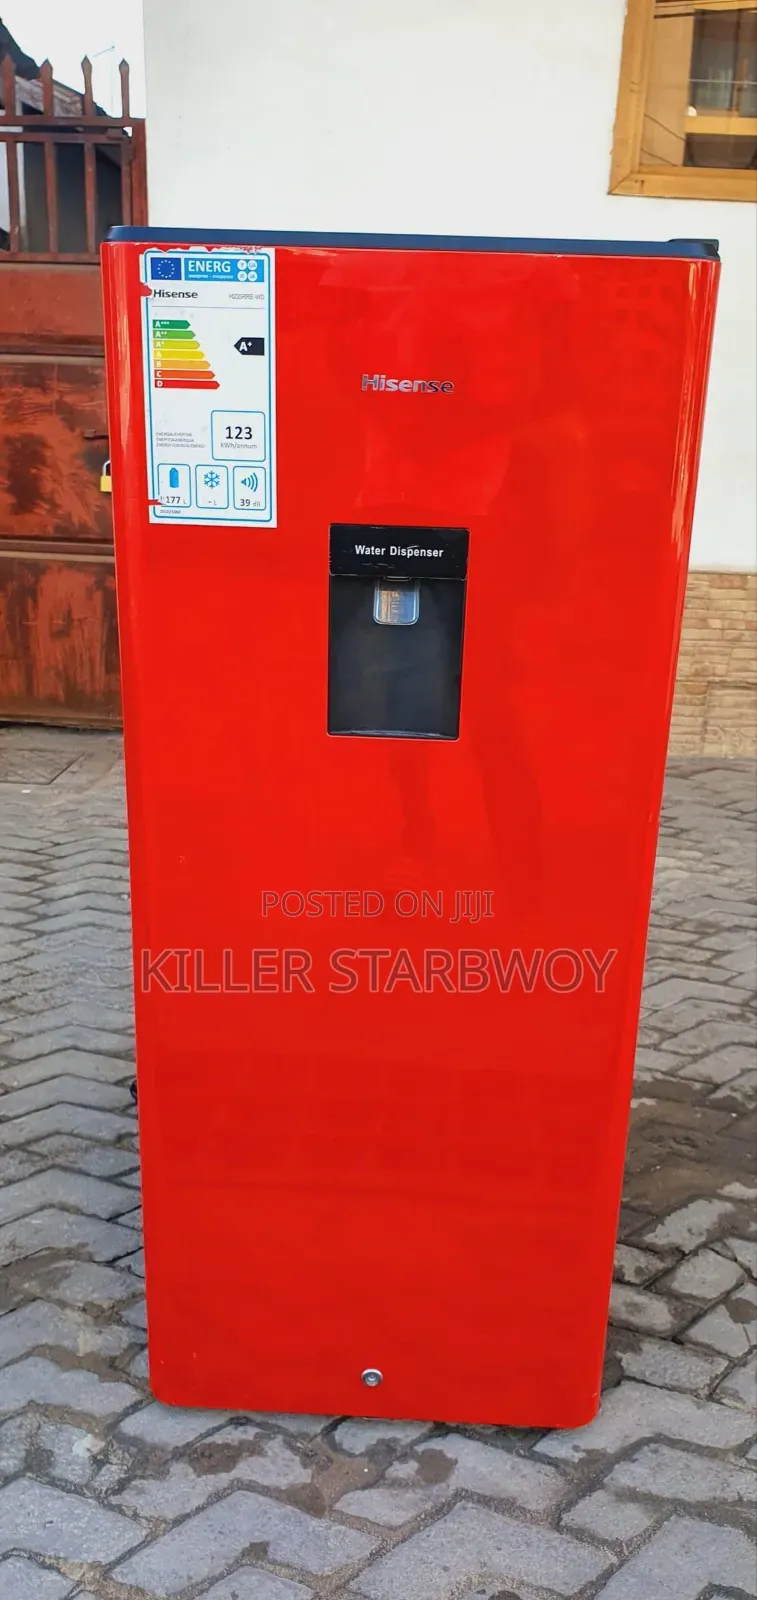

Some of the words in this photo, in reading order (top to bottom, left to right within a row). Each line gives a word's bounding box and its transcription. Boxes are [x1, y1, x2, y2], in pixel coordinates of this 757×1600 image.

[188, 260, 231, 273] ENERG
[153, 289, 199, 299] Hisense
[239, 341, 253, 352] A+
[156, 370, 162, 378] C
[361, 374, 455, 394] Hisense
[225, 426, 253, 440] 123
[220, 442, 258, 450] kWh/annum
[166, 496, 181, 504] 177
[240, 499, 251, 507] 39
[354, 544, 386, 556] Water
[389, 545, 444, 559] Dispenser
